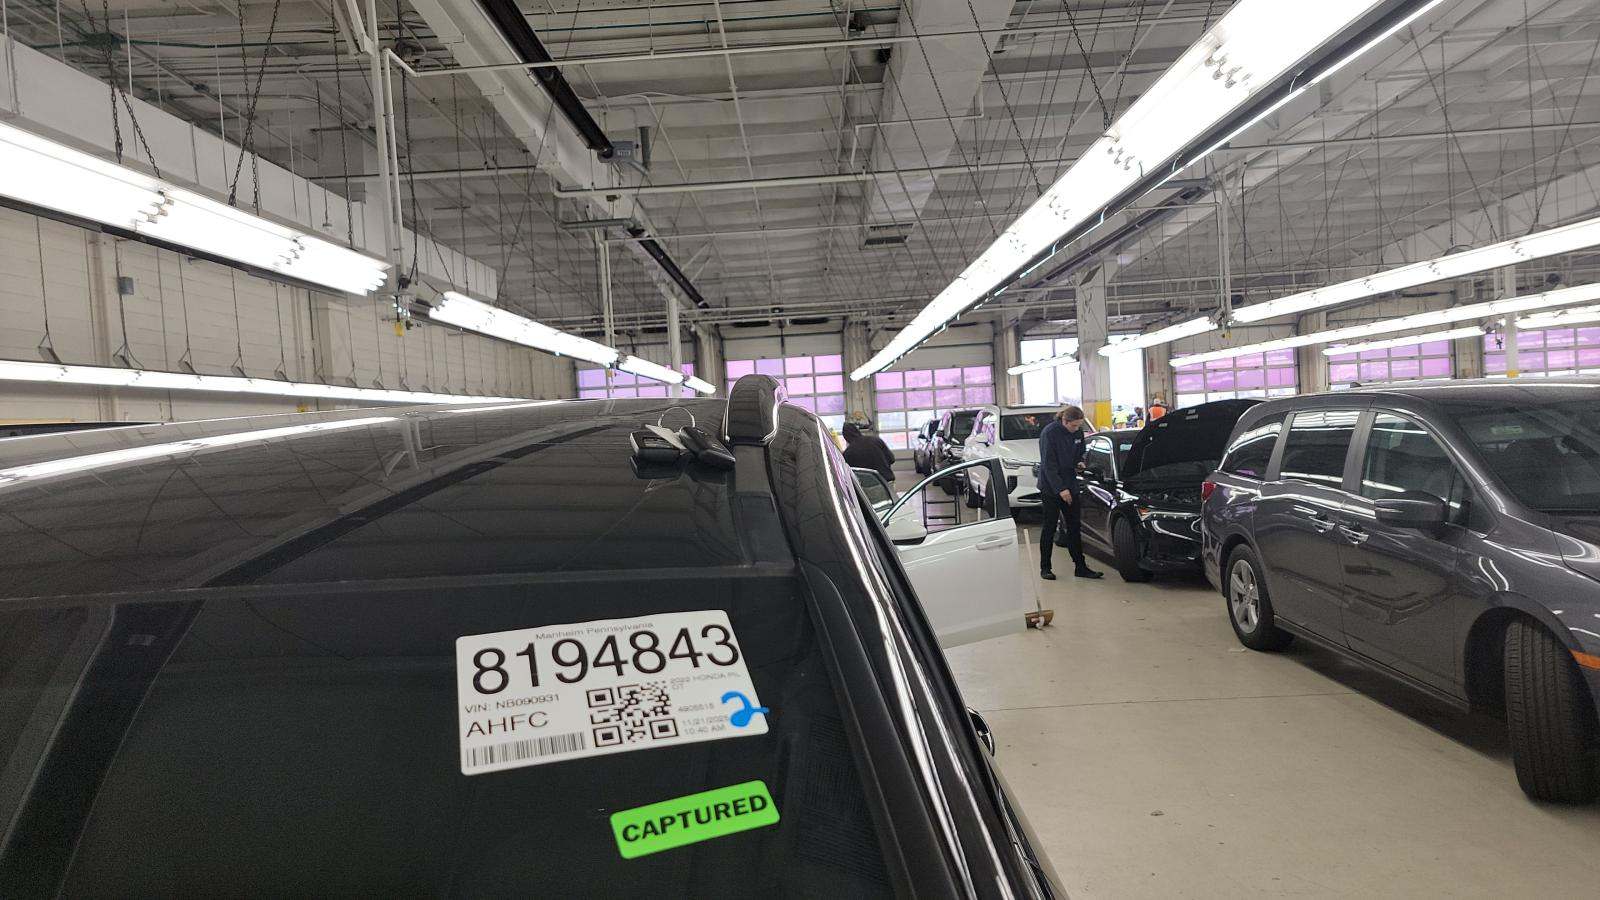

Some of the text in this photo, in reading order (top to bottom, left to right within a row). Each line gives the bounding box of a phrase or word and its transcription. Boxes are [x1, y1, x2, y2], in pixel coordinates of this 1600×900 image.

[535, 623, 654, 640] Manheim Pennsylvania
[473, 624, 739, 694] 8194843
[692, 673, 726, 682] HONDA
[465, 694, 560, 713] VIN: NB090931
[721, 691, 769, 727] 2
[466, 711, 548, 737] AHFC
[711, 723, 726, 732] AM
[622, 794, 768, 842] CAPTURED
